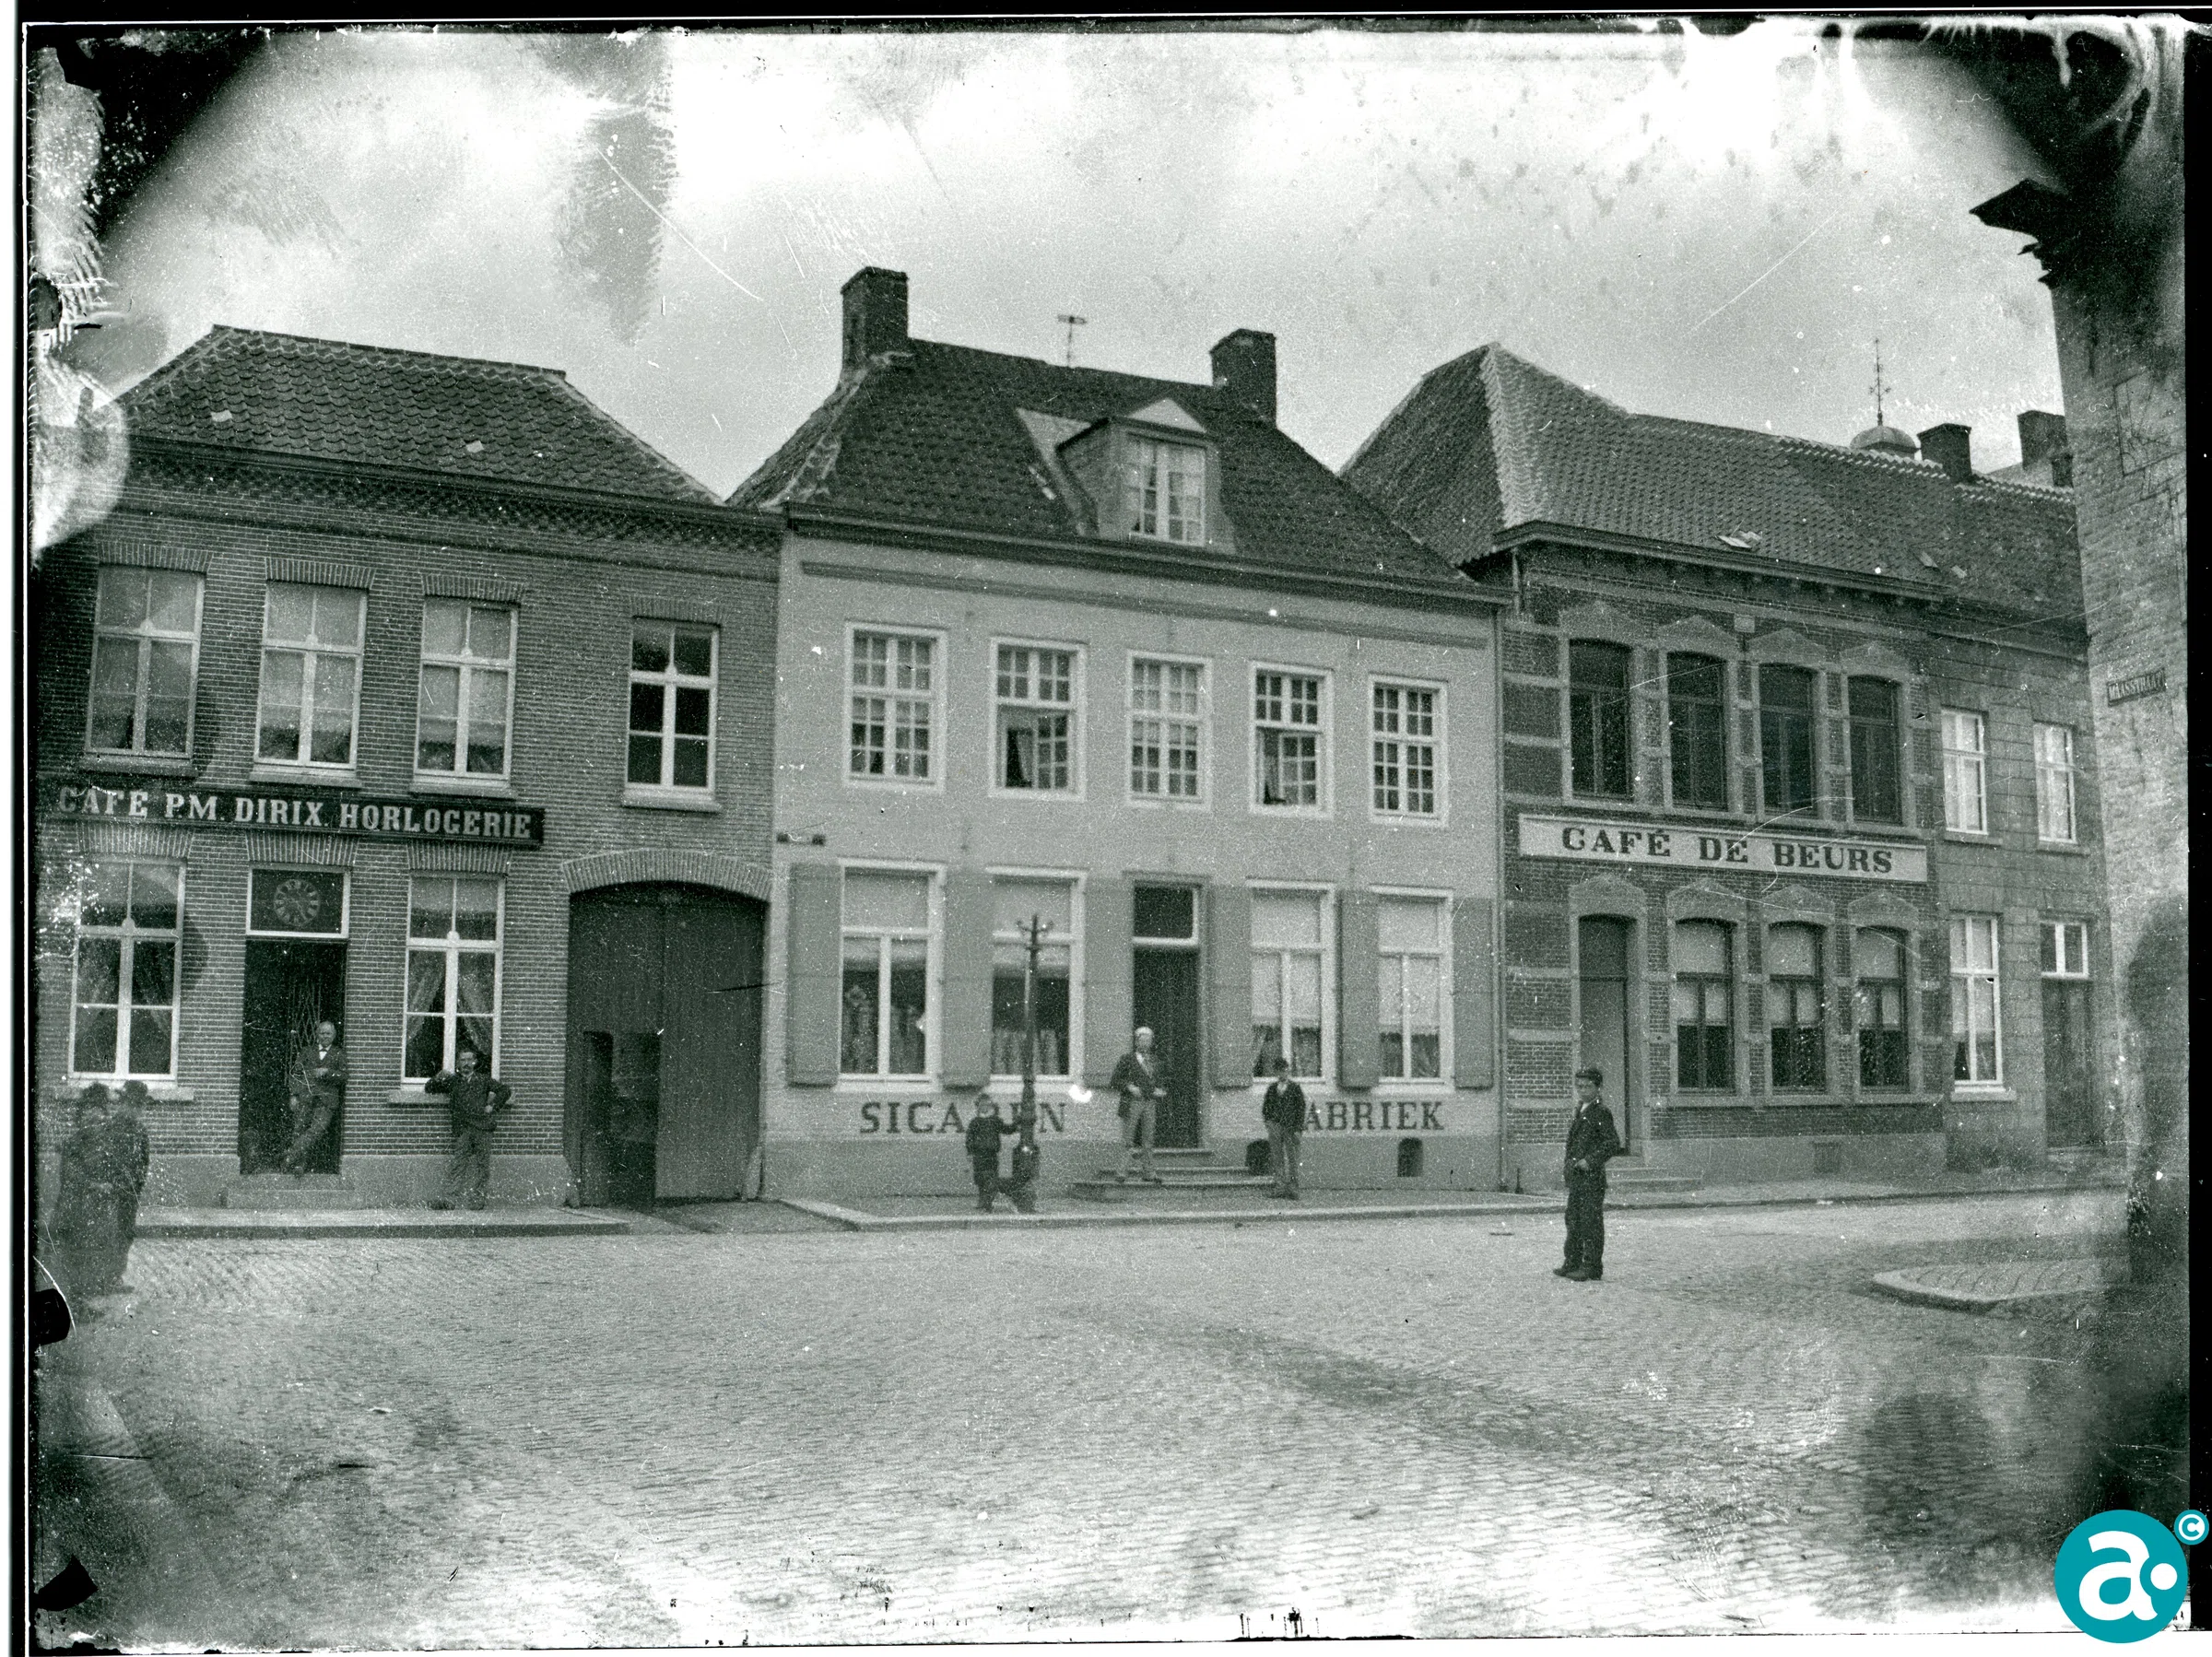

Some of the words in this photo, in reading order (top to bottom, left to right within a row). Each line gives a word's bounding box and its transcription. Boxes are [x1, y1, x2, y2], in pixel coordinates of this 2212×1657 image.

[339, 803, 532, 839] HORLOGERIE
[1698, 836, 1748, 864] DE
[1771, 842, 1892, 873] BEURS
[1302, 1100, 1444, 1131] ABRIEK
